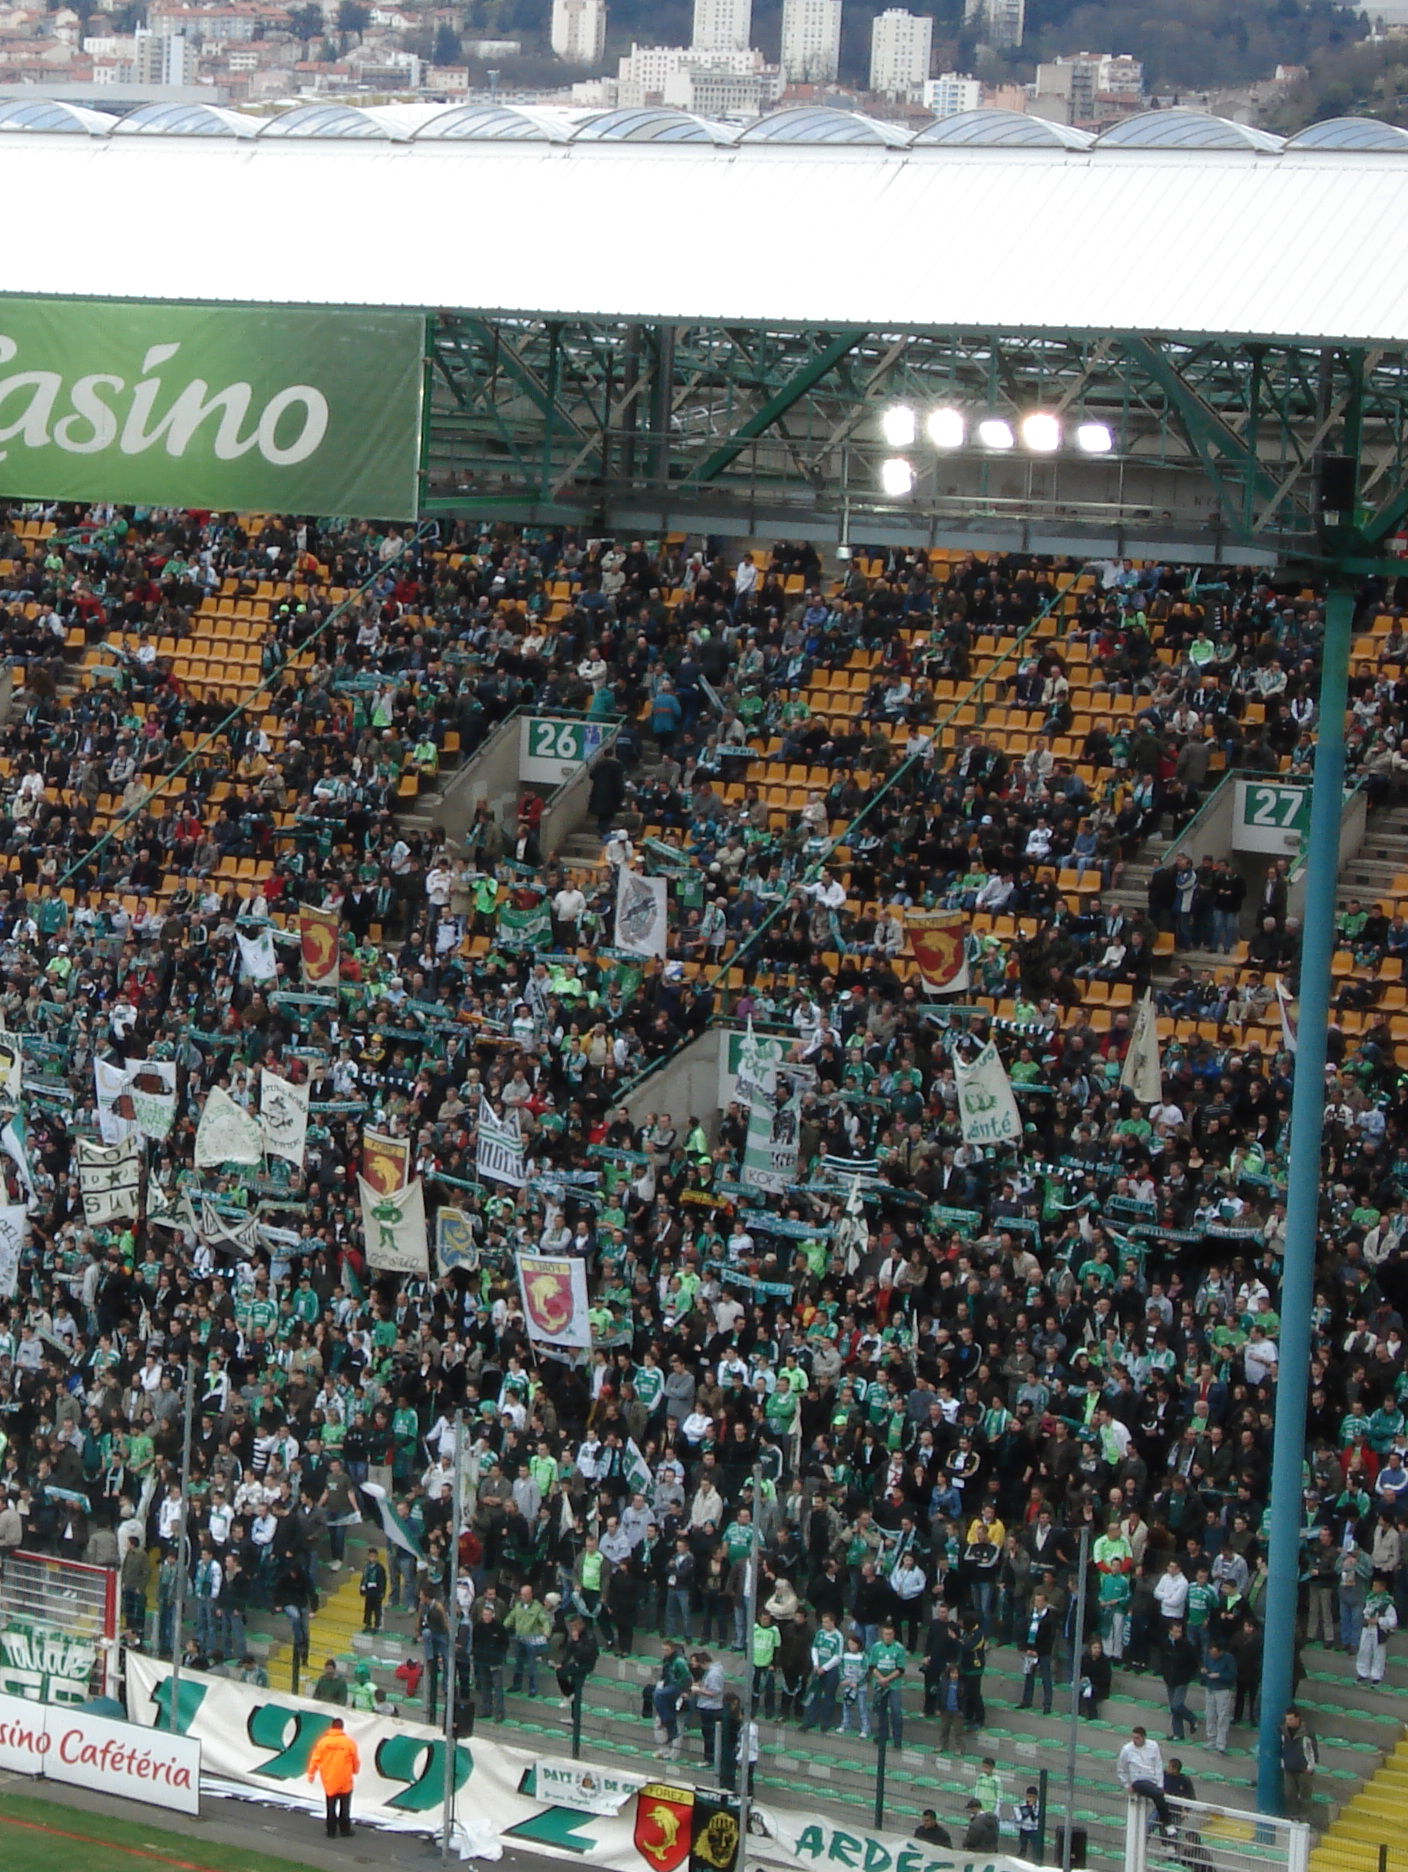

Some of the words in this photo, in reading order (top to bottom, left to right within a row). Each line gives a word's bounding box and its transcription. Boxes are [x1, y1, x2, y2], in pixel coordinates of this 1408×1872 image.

[534, 721, 577, 756] 26
[1253, 786, 1304, 828] 27
[79, 1135, 137, 1162] KOP
[59, 1727, 191, 1791] Cafétéria
[648, 1786, 685, 1802] FOREZ
